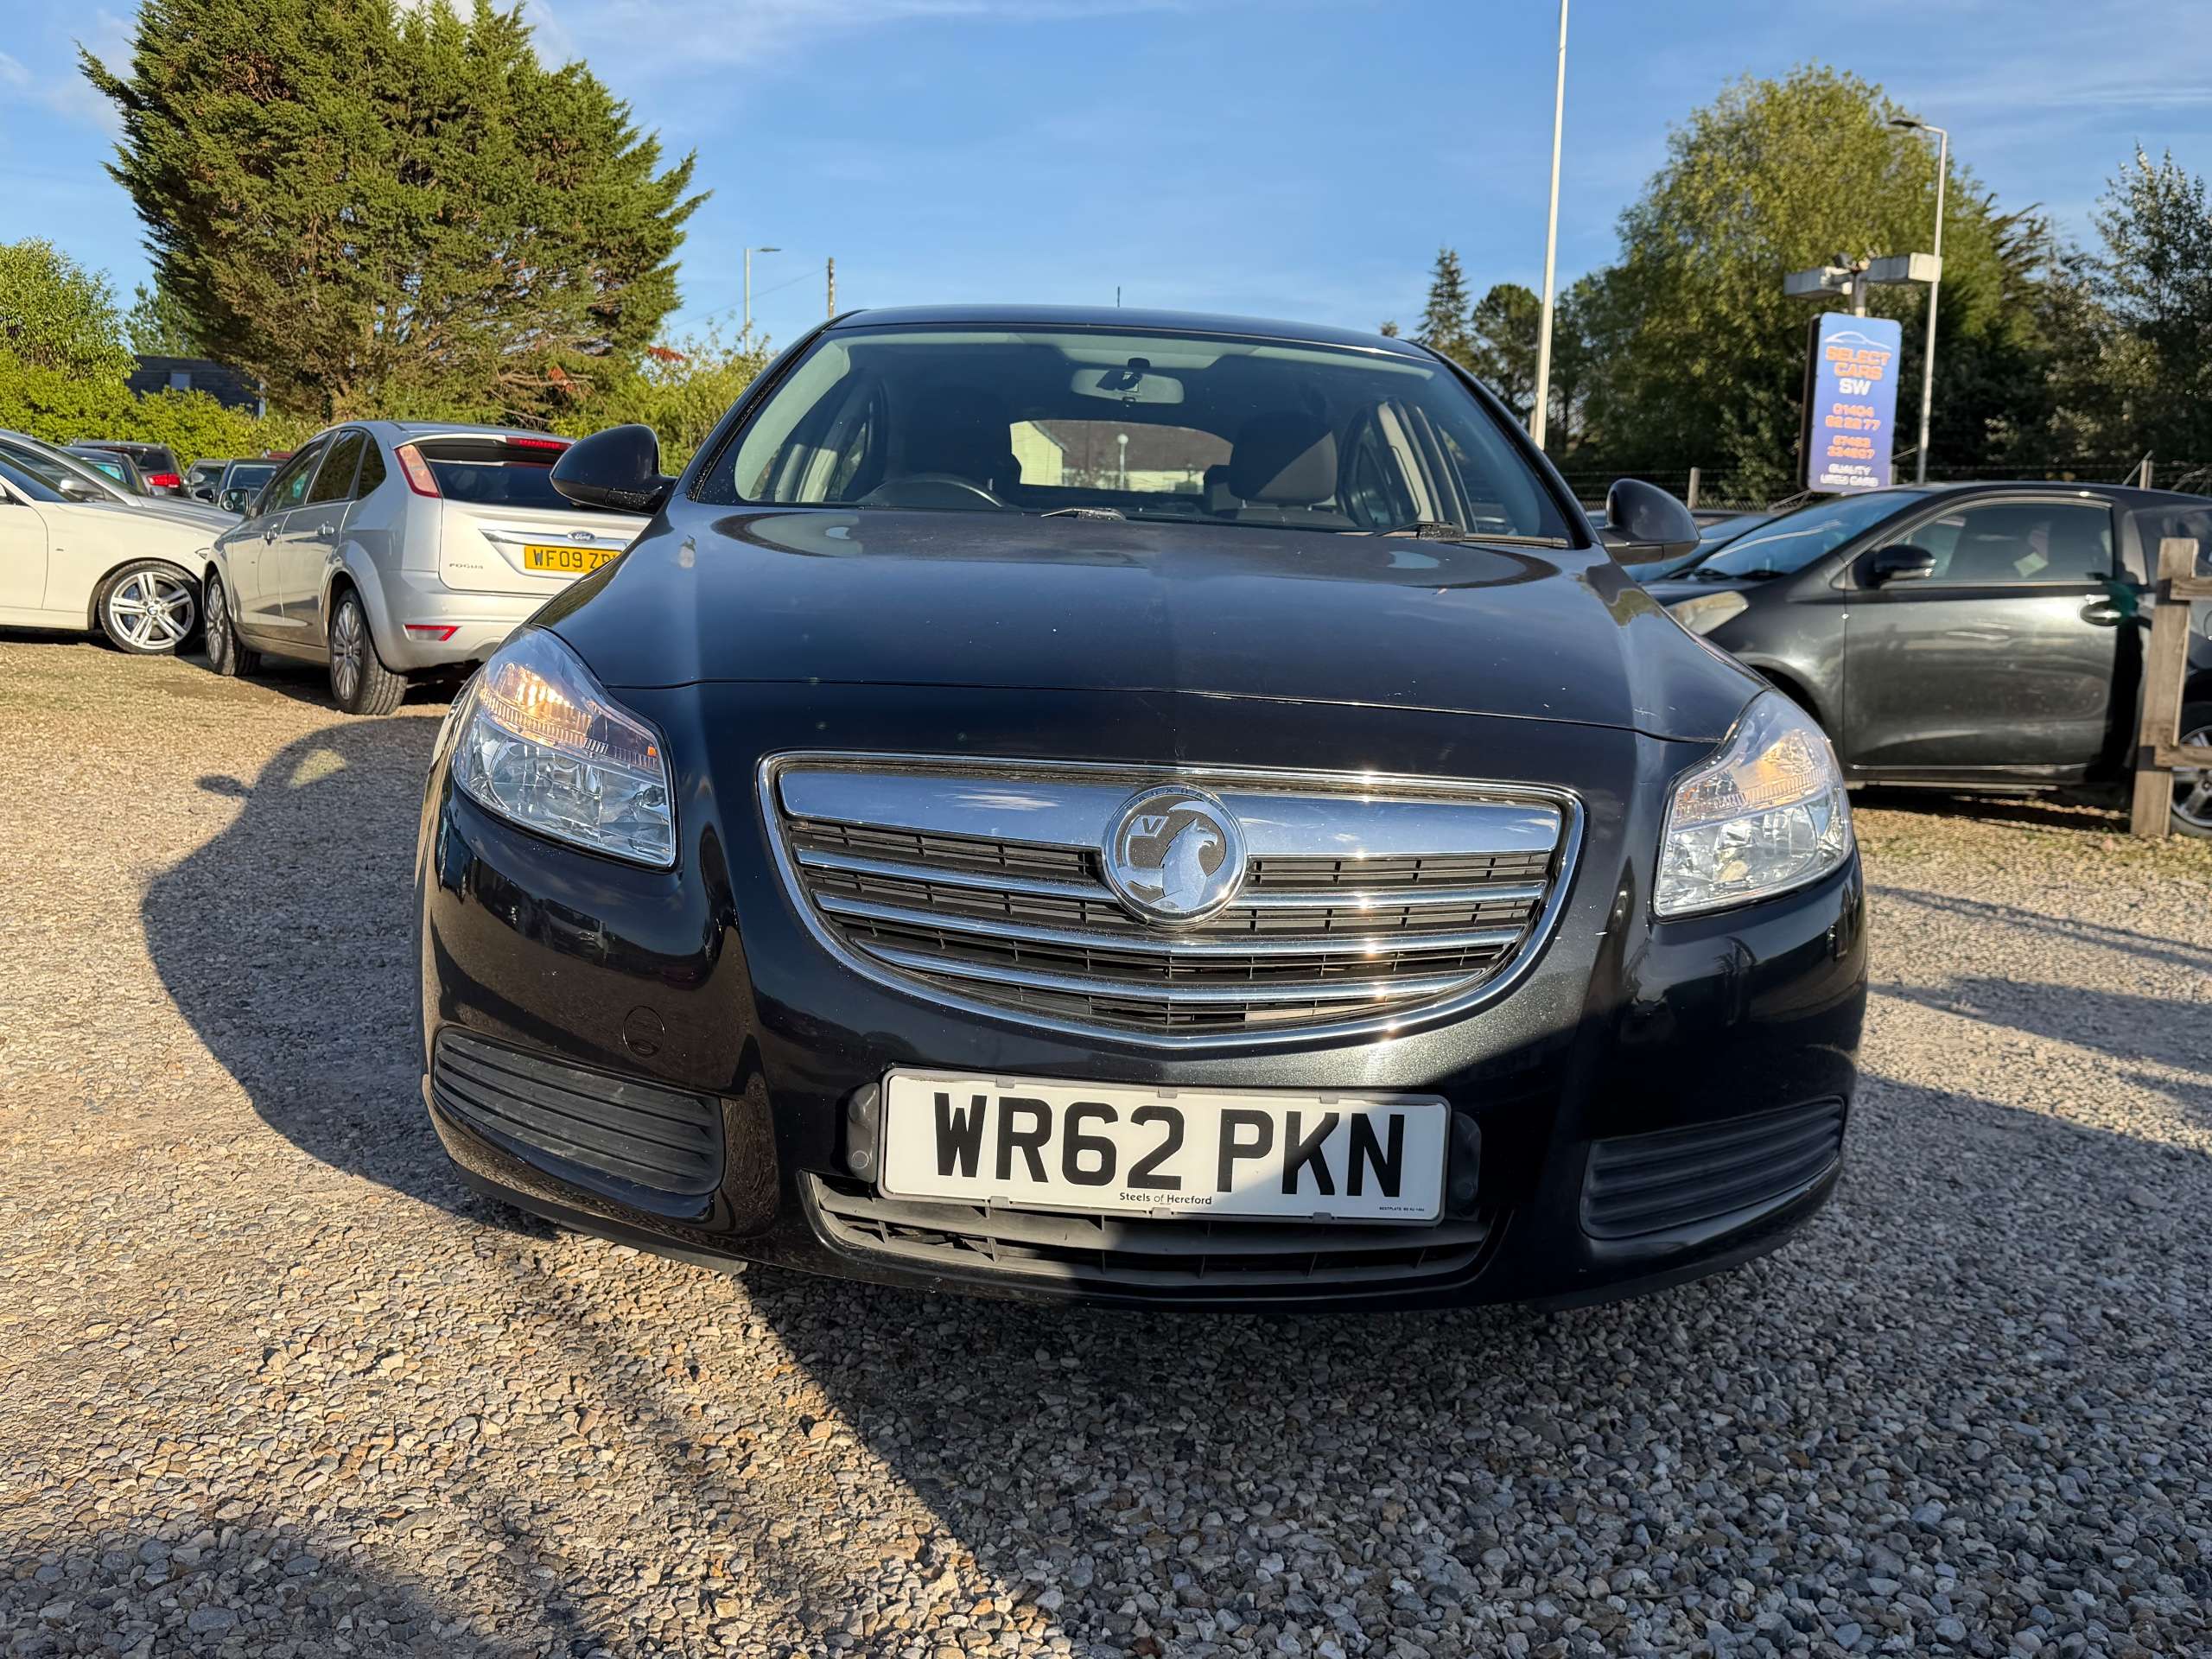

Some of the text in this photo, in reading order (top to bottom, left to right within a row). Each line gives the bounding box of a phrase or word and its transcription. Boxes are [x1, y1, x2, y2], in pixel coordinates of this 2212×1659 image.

[1825, 346, 1891, 366] SELECT
[1834, 362, 1883, 380] CARS
[1839, 378, 1872, 396] SW
[1828, 463, 1872, 476] QUALITY
[1820, 473, 1849, 486] USED
[533, 549, 583, 569] WF09
[933, 1091, 1405, 1198] WR62 PKN
[1119, 1192, 1212, 1205] Steels of Hereford
